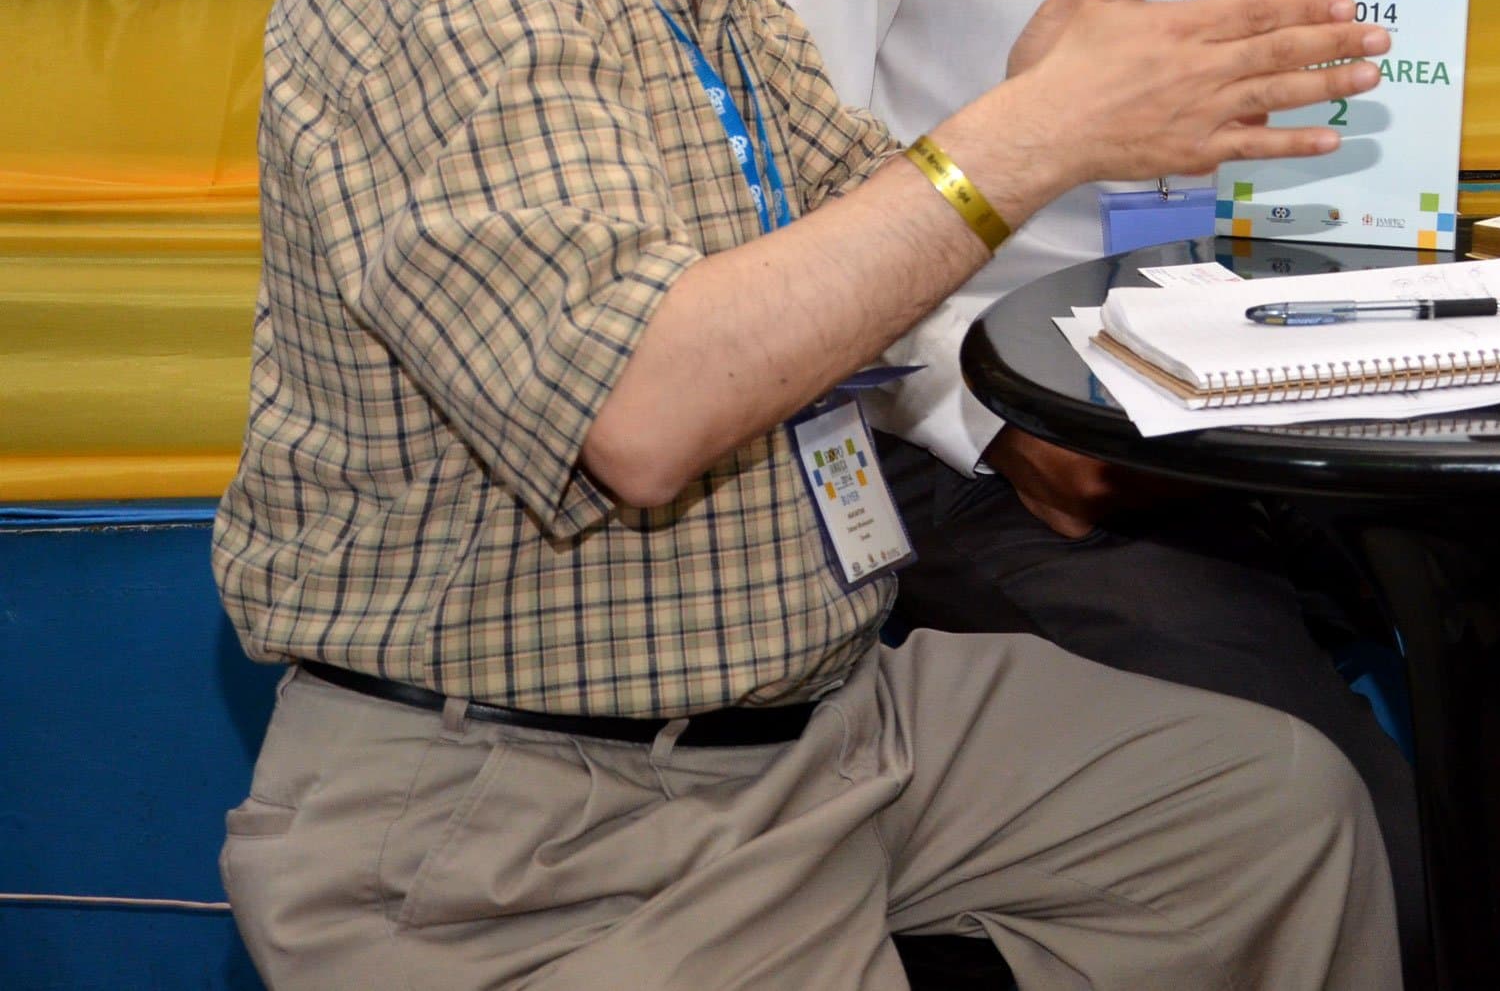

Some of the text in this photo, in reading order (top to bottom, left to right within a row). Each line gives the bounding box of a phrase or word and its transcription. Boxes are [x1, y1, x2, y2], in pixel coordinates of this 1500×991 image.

[1354, 1, 1398, 23] 014
[1379, 58, 1451, 86] AREA
[1328, 97, 1349, 127] 2
